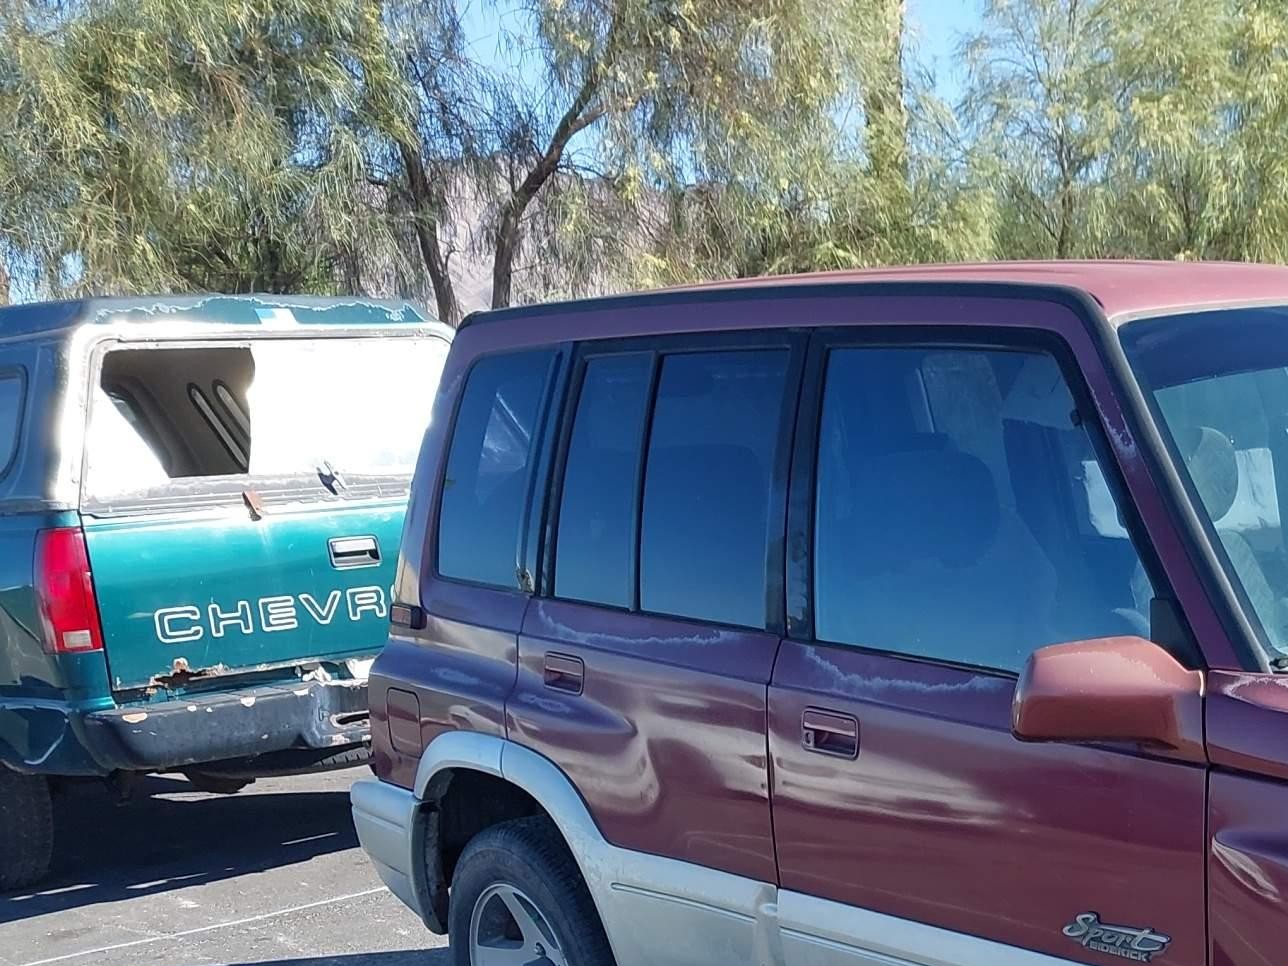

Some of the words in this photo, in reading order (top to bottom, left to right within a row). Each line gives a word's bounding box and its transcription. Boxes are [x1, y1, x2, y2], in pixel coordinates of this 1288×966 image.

[153, 585, 396, 644] CHEVR
[1062, 912, 1170, 951] Sport
[1088, 940, 1148, 963] SIDEKICK
